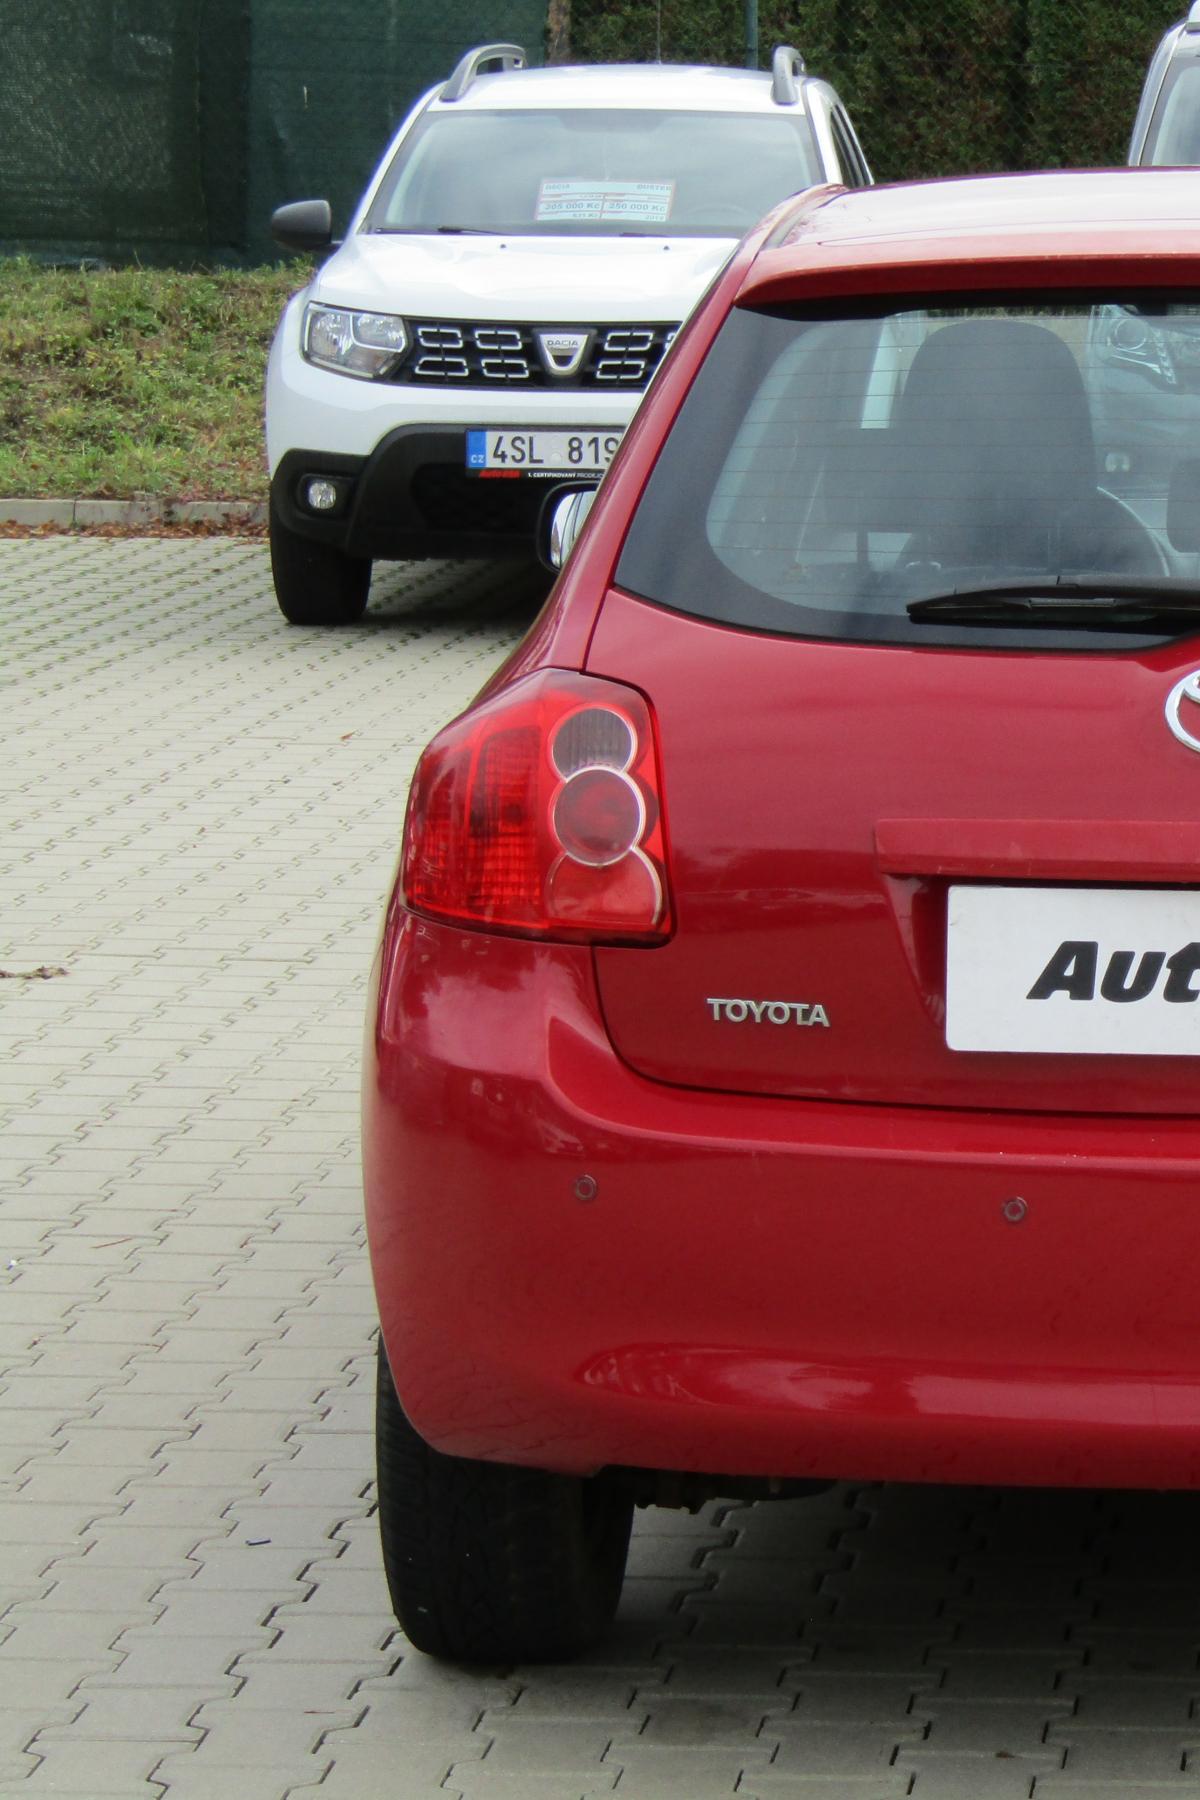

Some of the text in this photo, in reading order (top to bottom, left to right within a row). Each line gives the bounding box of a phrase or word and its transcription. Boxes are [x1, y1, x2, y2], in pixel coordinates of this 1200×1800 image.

[471, 454, 485, 463] CZ
[493, 436, 544, 464] 4SL
[706, 998, 830, 1027] TOYOTA
